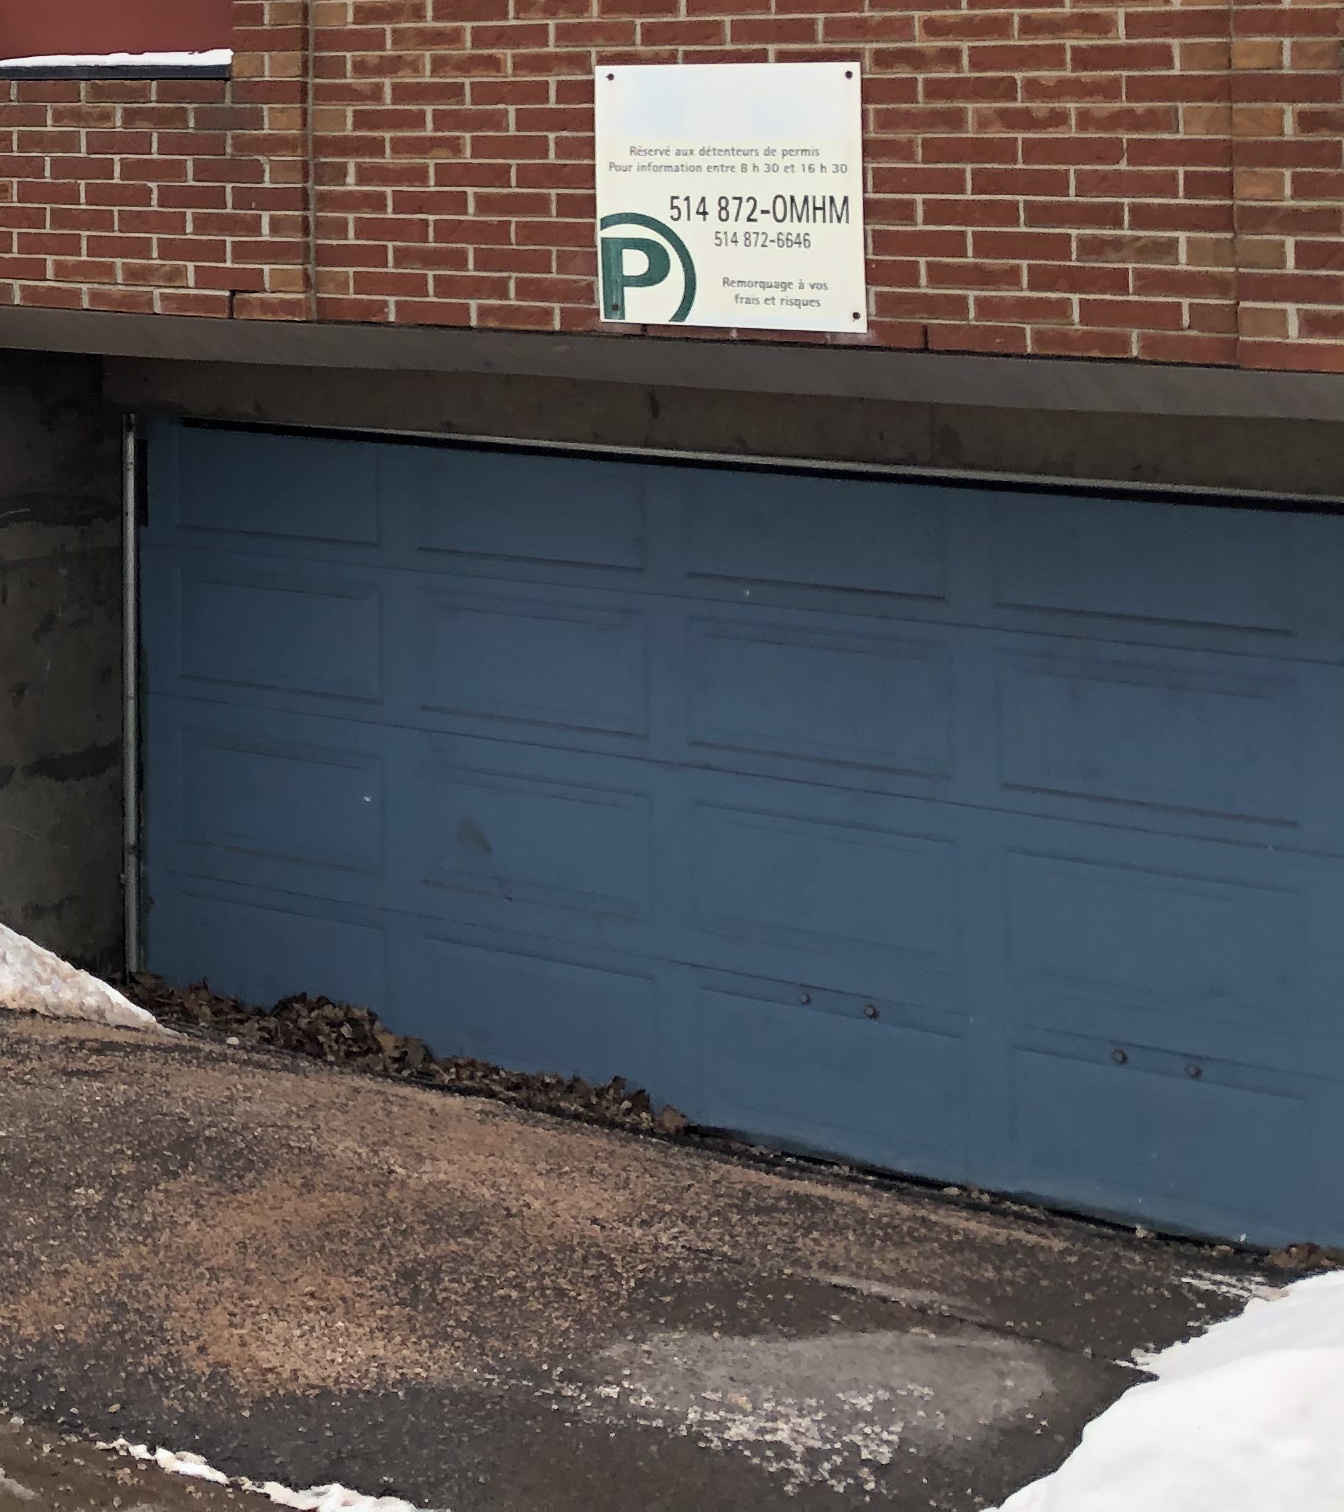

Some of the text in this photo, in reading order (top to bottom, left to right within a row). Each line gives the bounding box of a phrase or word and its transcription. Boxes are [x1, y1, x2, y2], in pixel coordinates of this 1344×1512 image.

[629, 145, 820, 159] Réservé aux détenteurs de permis
[608, 161, 848, 174] Pour information entre 8 h 30 et 16 h 30
[669, 194, 850, 224] 514 872-OMHM
[714, 231, 811, 249] 514 872-6646
[600, 237, 671, 320] P
[722, 276, 828, 292] Remorquage à vos
[734, 293, 821, 309] frais et risques
